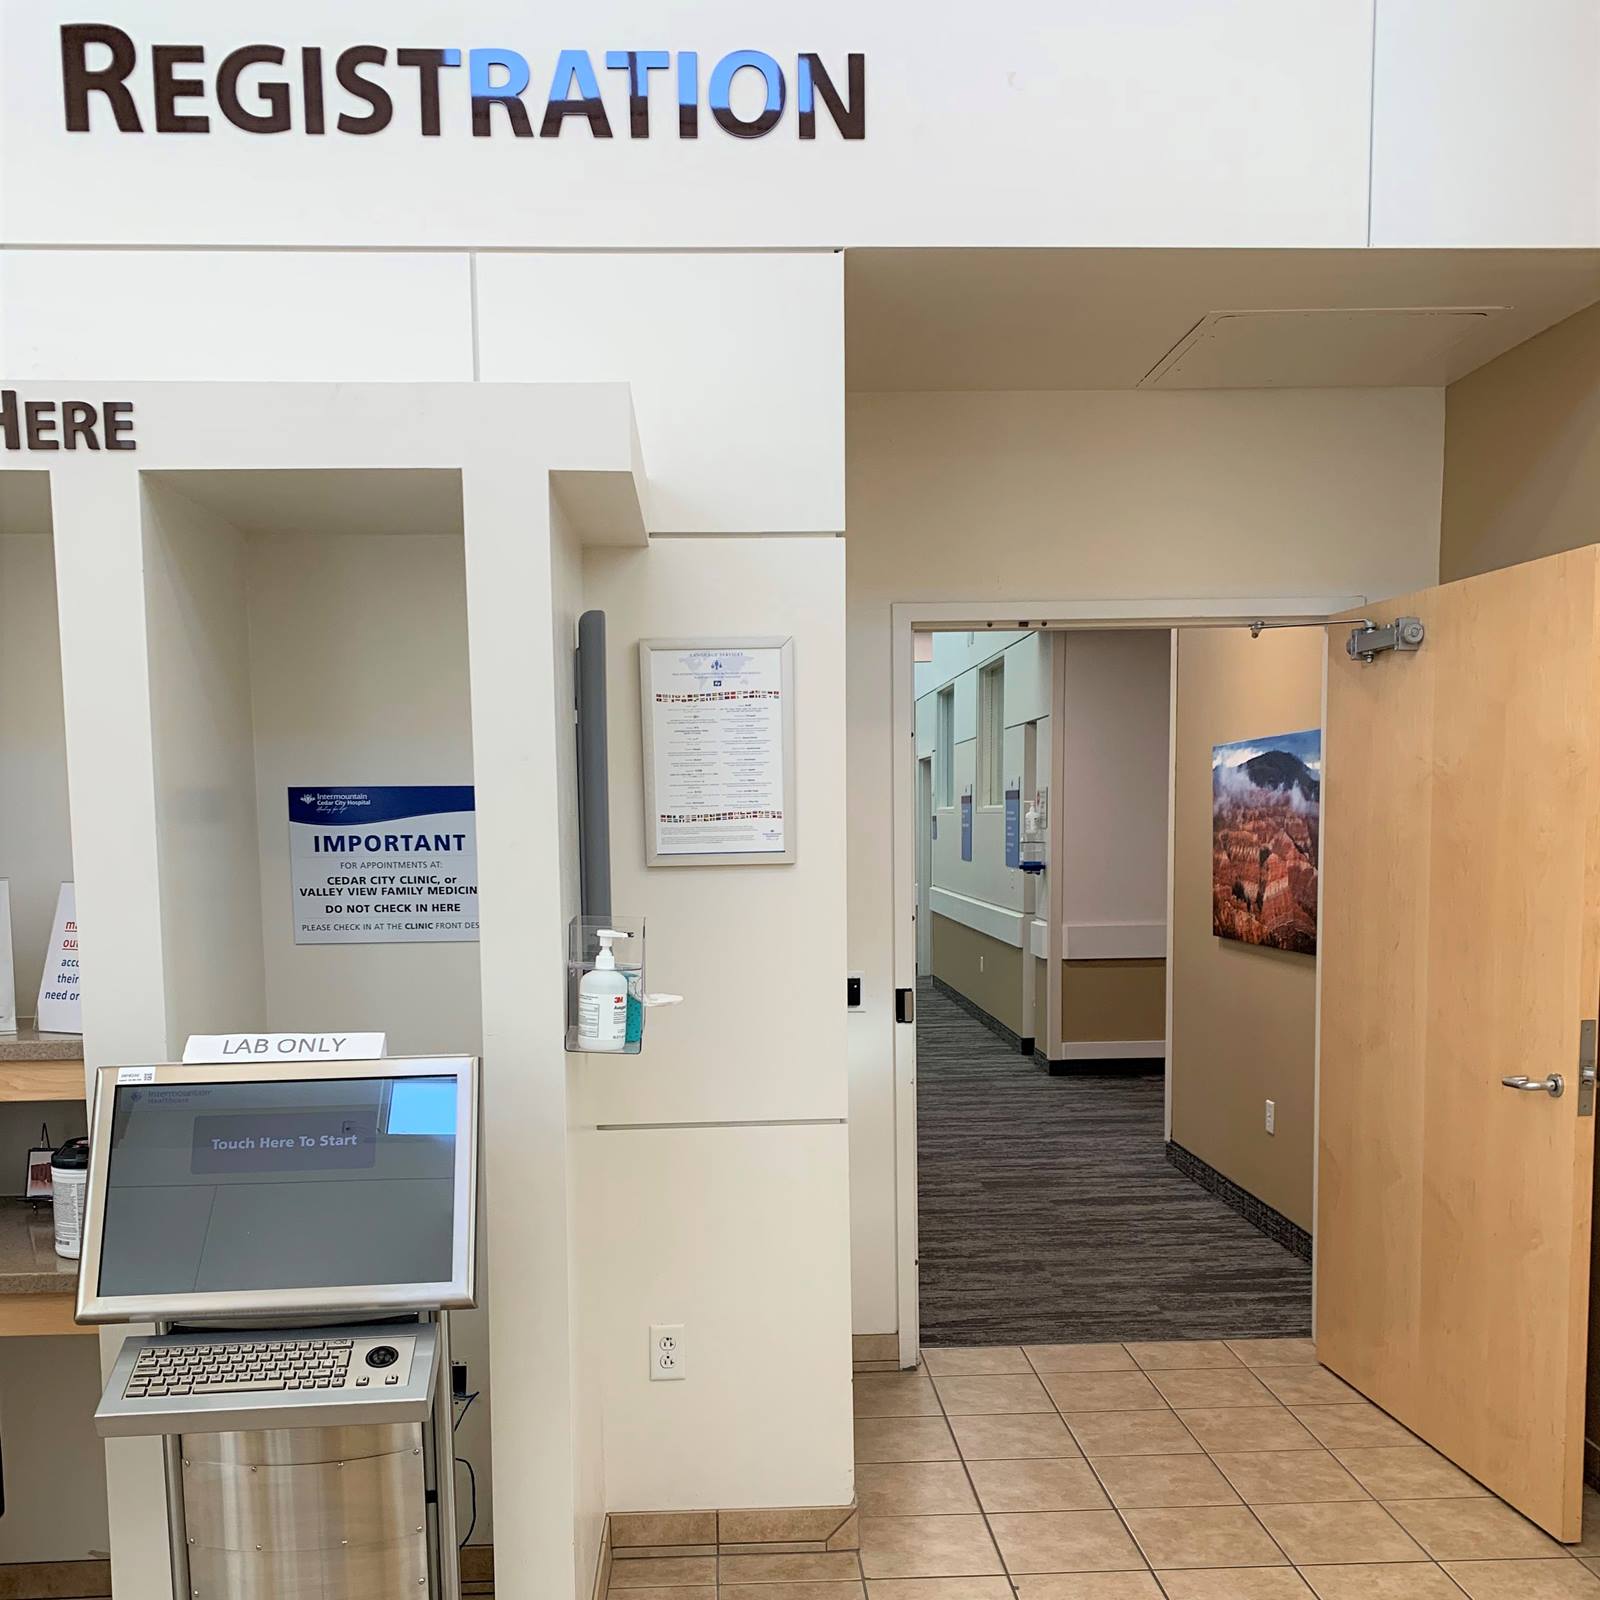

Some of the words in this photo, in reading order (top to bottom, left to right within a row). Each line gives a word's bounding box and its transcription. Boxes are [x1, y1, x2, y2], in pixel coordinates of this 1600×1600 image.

[60, 23, 866, 140] REGISTRATION
[0, 390, 136, 450] HERE
[314, 834, 466, 852] IMPORTANT
[360, 861, 427, 869] APPOINTMENTS
[327, 876, 366, 885] CEDAR
[370, 876, 395, 885] CITY
[400, 876, 440, 885] CLINIC,
[300, 887, 343, 897] VALLEY
[347, 887, 377, 896] VIEW
[381, 887, 423, 895] FAMILY
[427, 886, 478, 895] MEDICIN
[325, 905, 342, 913] DO
[347, 905, 370, 913] NOT
[374, 904, 412, 913] CHECK
[416, 904, 428, 912] IN
[432, 904, 461, 912] HERE
[333, 923, 360, 931] CHECK
[57, 973, 79, 984] their
[45, 990, 67, 1000] need
[222, 1038, 269, 1055] LAB
[277, 1037, 347, 1054] ONLY
[212, 1137, 255, 1150] Touch
[260, 1137, 295, 1148] Here
[299, 1135, 315, 1147] To
[319, 1134, 358, 1146] Start
